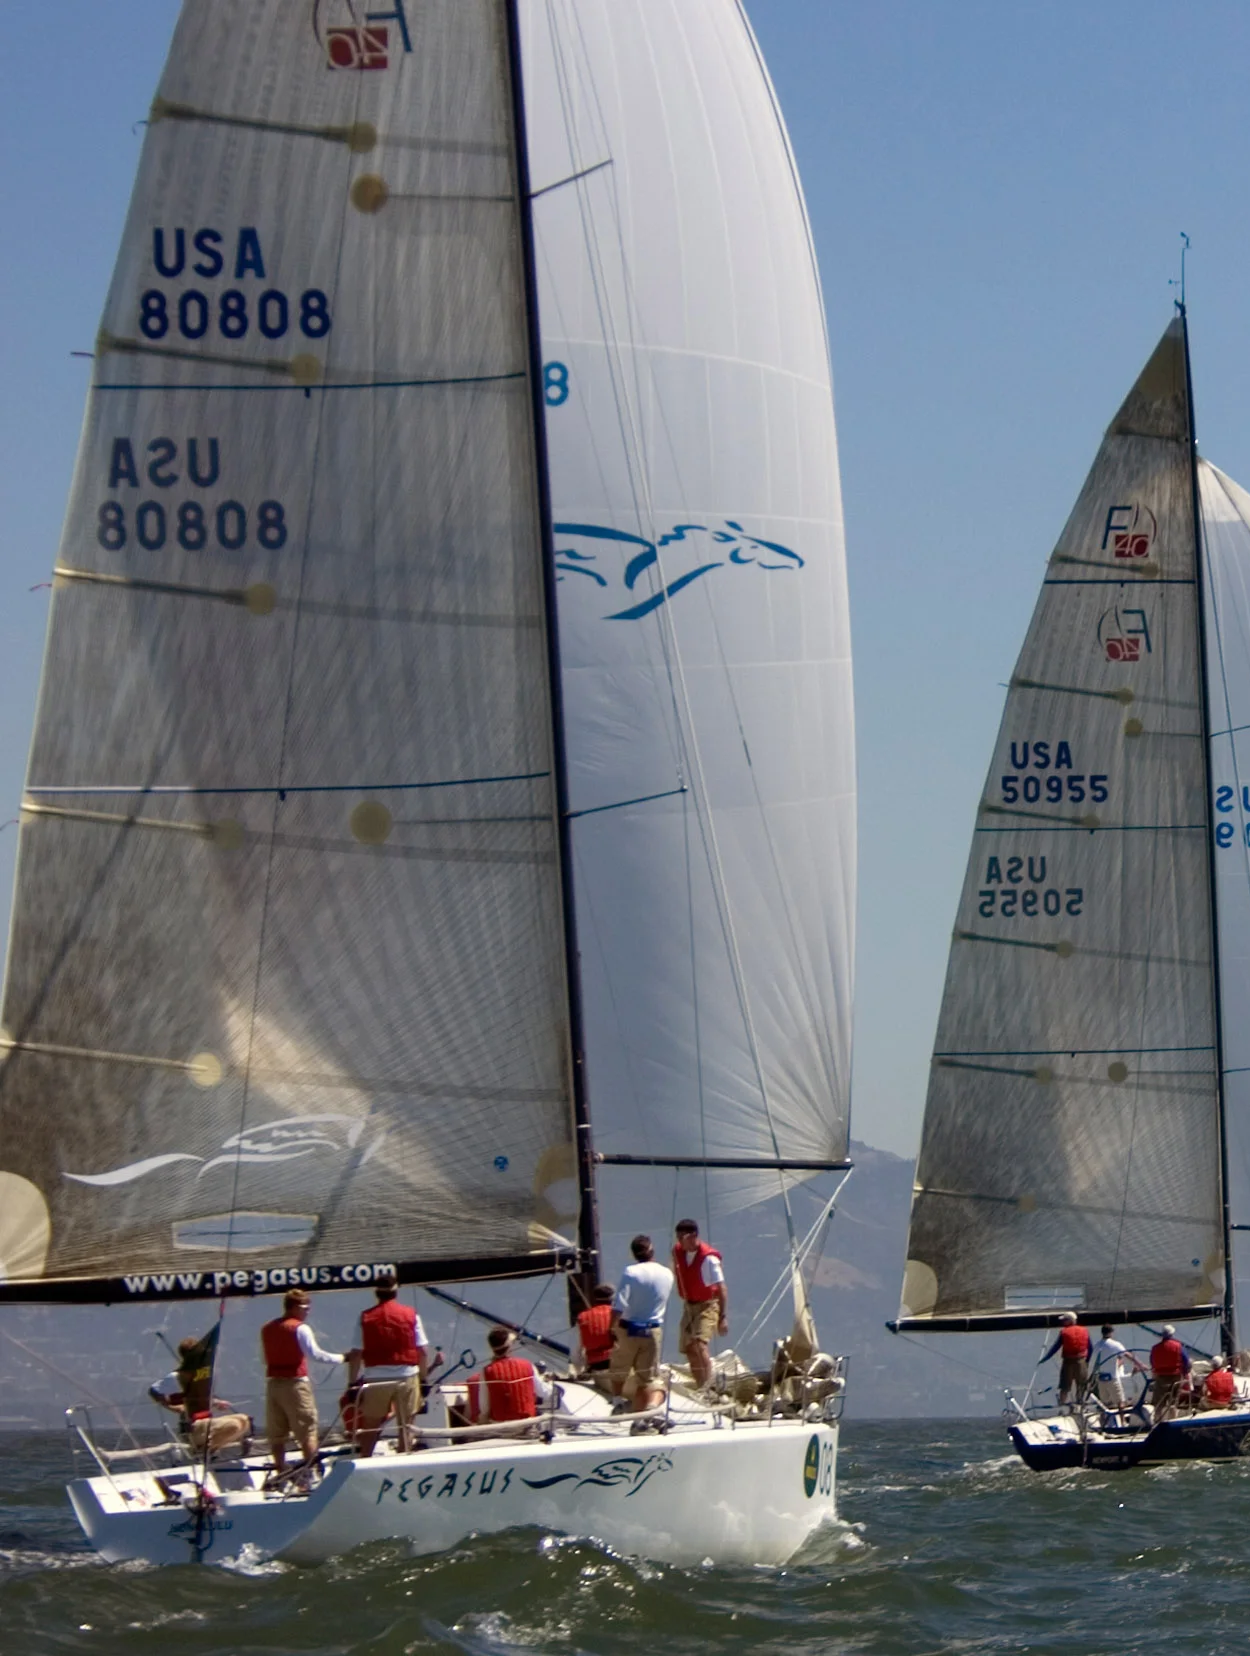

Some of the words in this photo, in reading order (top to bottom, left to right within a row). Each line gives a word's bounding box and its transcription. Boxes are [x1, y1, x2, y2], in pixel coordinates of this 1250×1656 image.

[153, 227, 266, 279] USA
[139, 289, 331, 339] 80808
[543, 361, 569, 407] 8
[1010, 741, 1073, 769] USA
[1001, 775, 1109, 803] 50955
[124, 1263, 397, 1294] www.pegasus.com
[376, 1467, 514, 1505] PEGASUS
